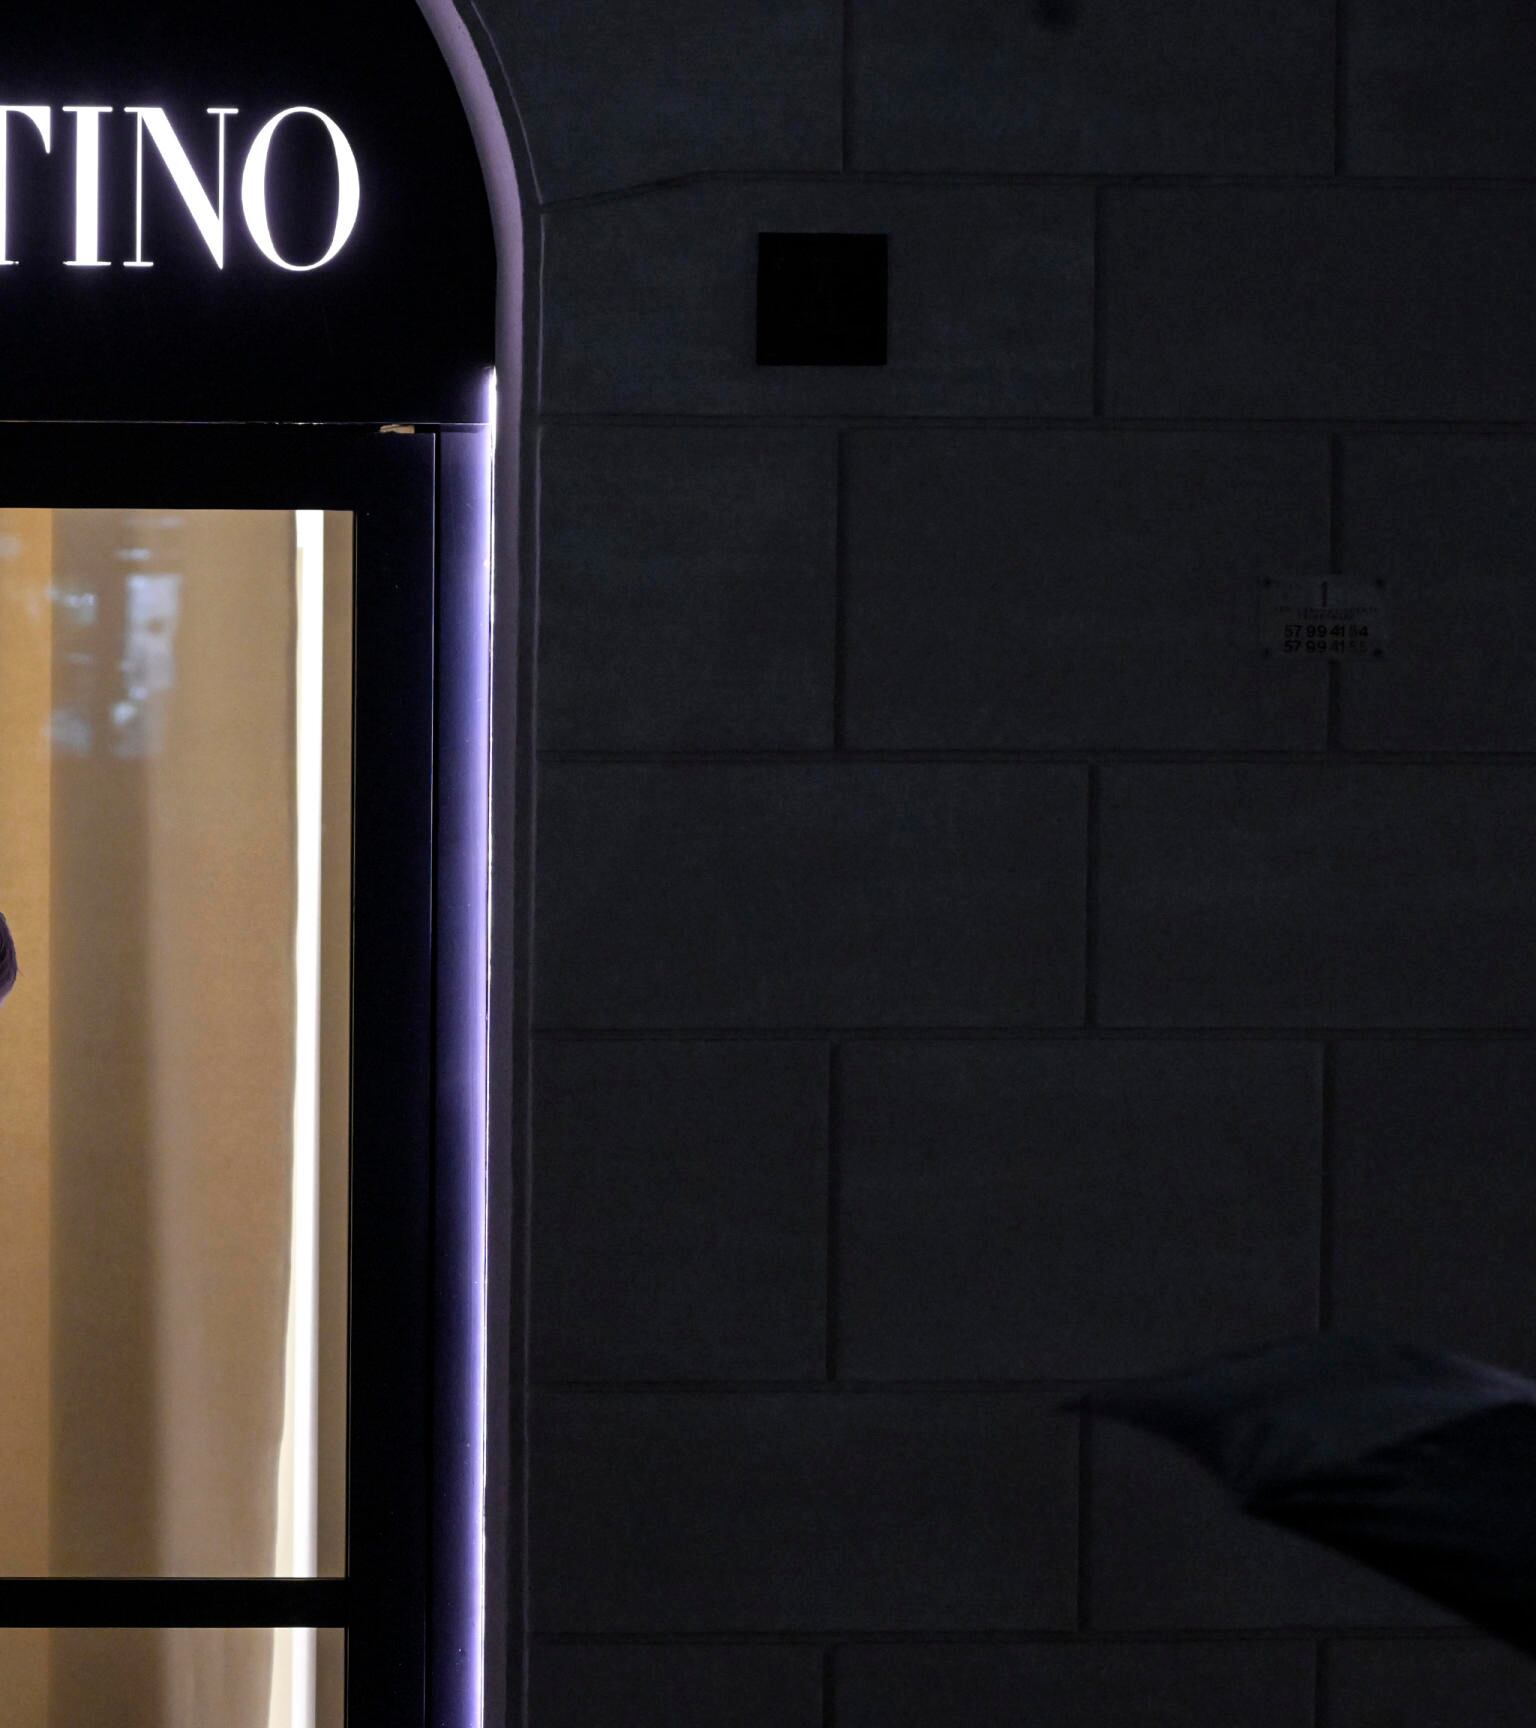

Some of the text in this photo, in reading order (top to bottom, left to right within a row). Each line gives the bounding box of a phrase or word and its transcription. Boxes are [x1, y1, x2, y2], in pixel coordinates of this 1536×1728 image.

[1306, 624, 1327, 638] 99
[1329, 624, 1344, 638] 41
[1284, 640, 1302, 653] 57
[1305, 640, 1327, 653] 99
[1330, 640, 1344, 653] 41
